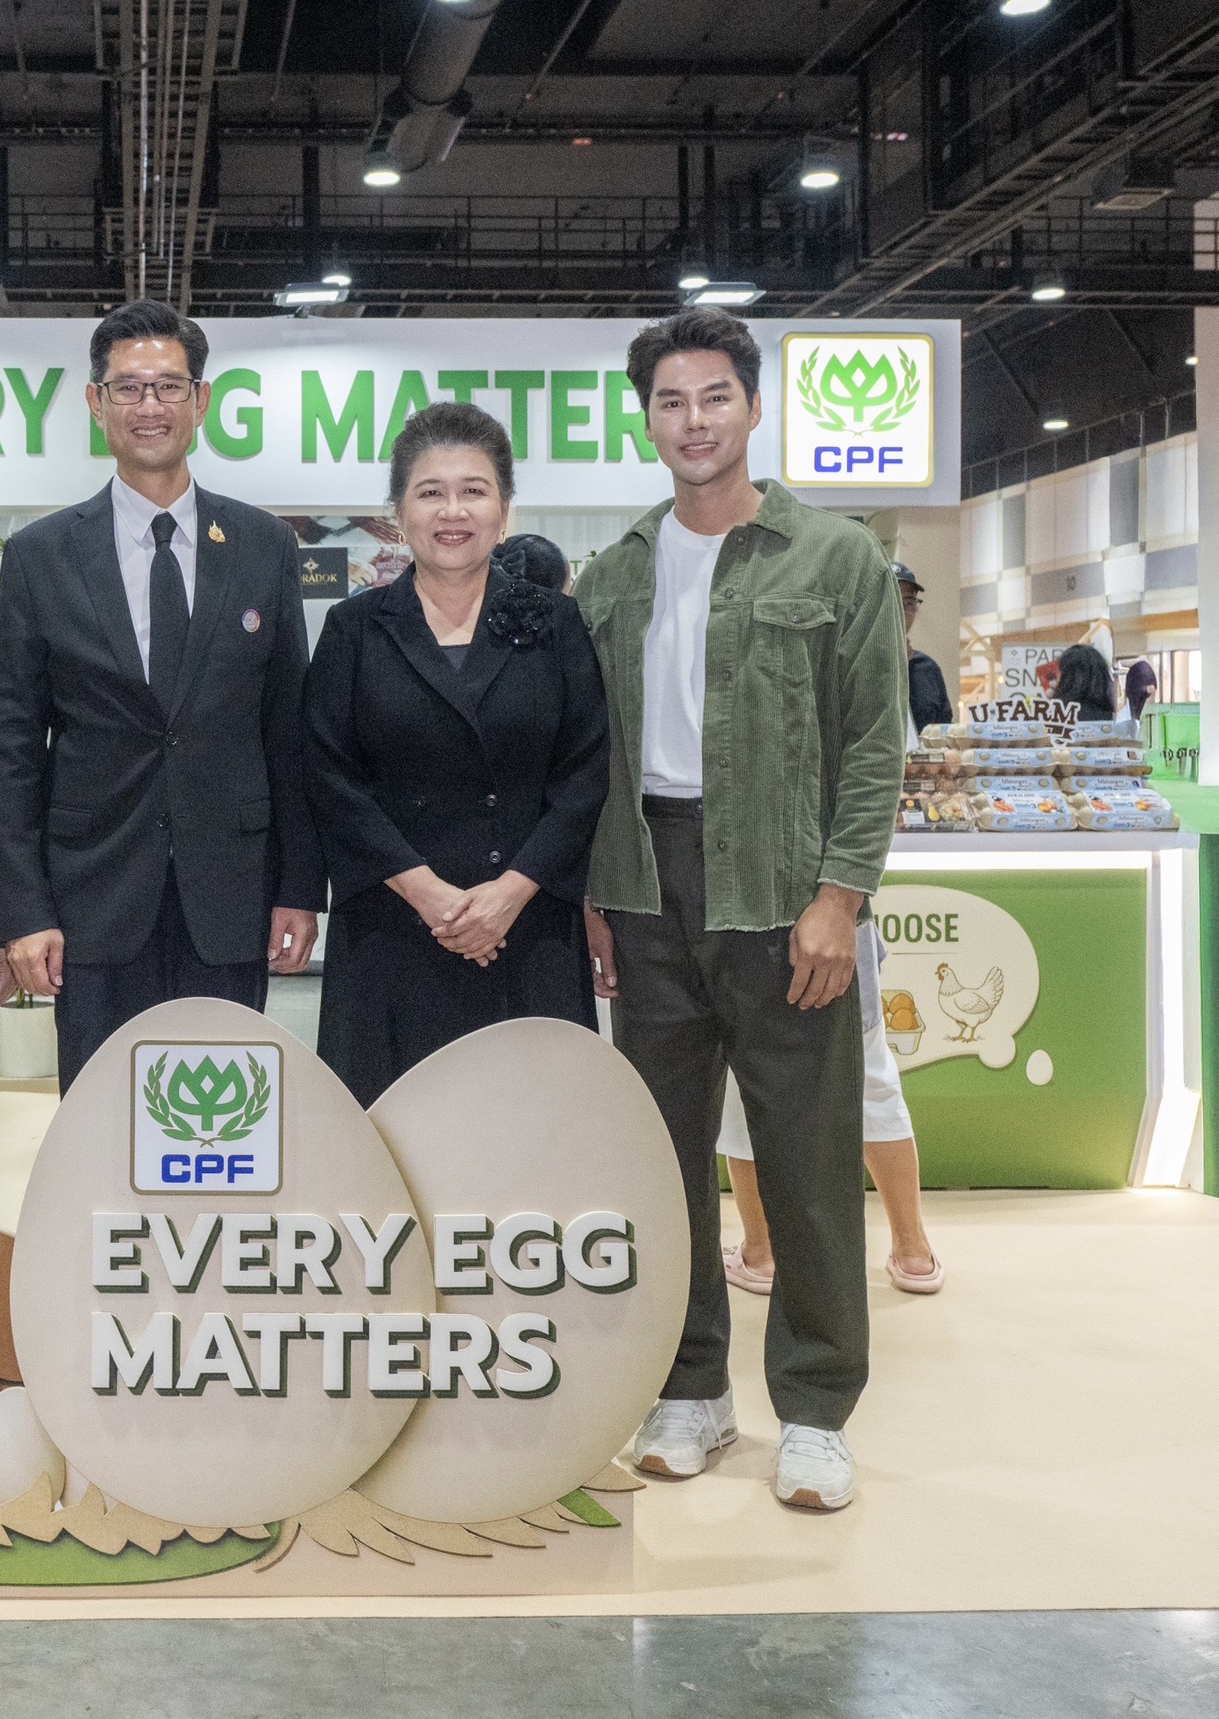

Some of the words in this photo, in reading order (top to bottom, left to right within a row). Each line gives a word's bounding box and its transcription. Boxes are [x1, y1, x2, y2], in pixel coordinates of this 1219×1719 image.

[301, 370, 660, 462] MATTER
[814, 446, 903, 473] CPF
[302, 573, 338, 583] RADOK
[995, 700, 1078, 726] FARM
[874, 913, 959, 943] OOSE
[161, 1153, 254, 1184] CPF
[91, 1212, 417, 1295] EVERY
[434, 1210, 638, 1295] EGG
[90, 1311, 562, 1399] MATTERS
